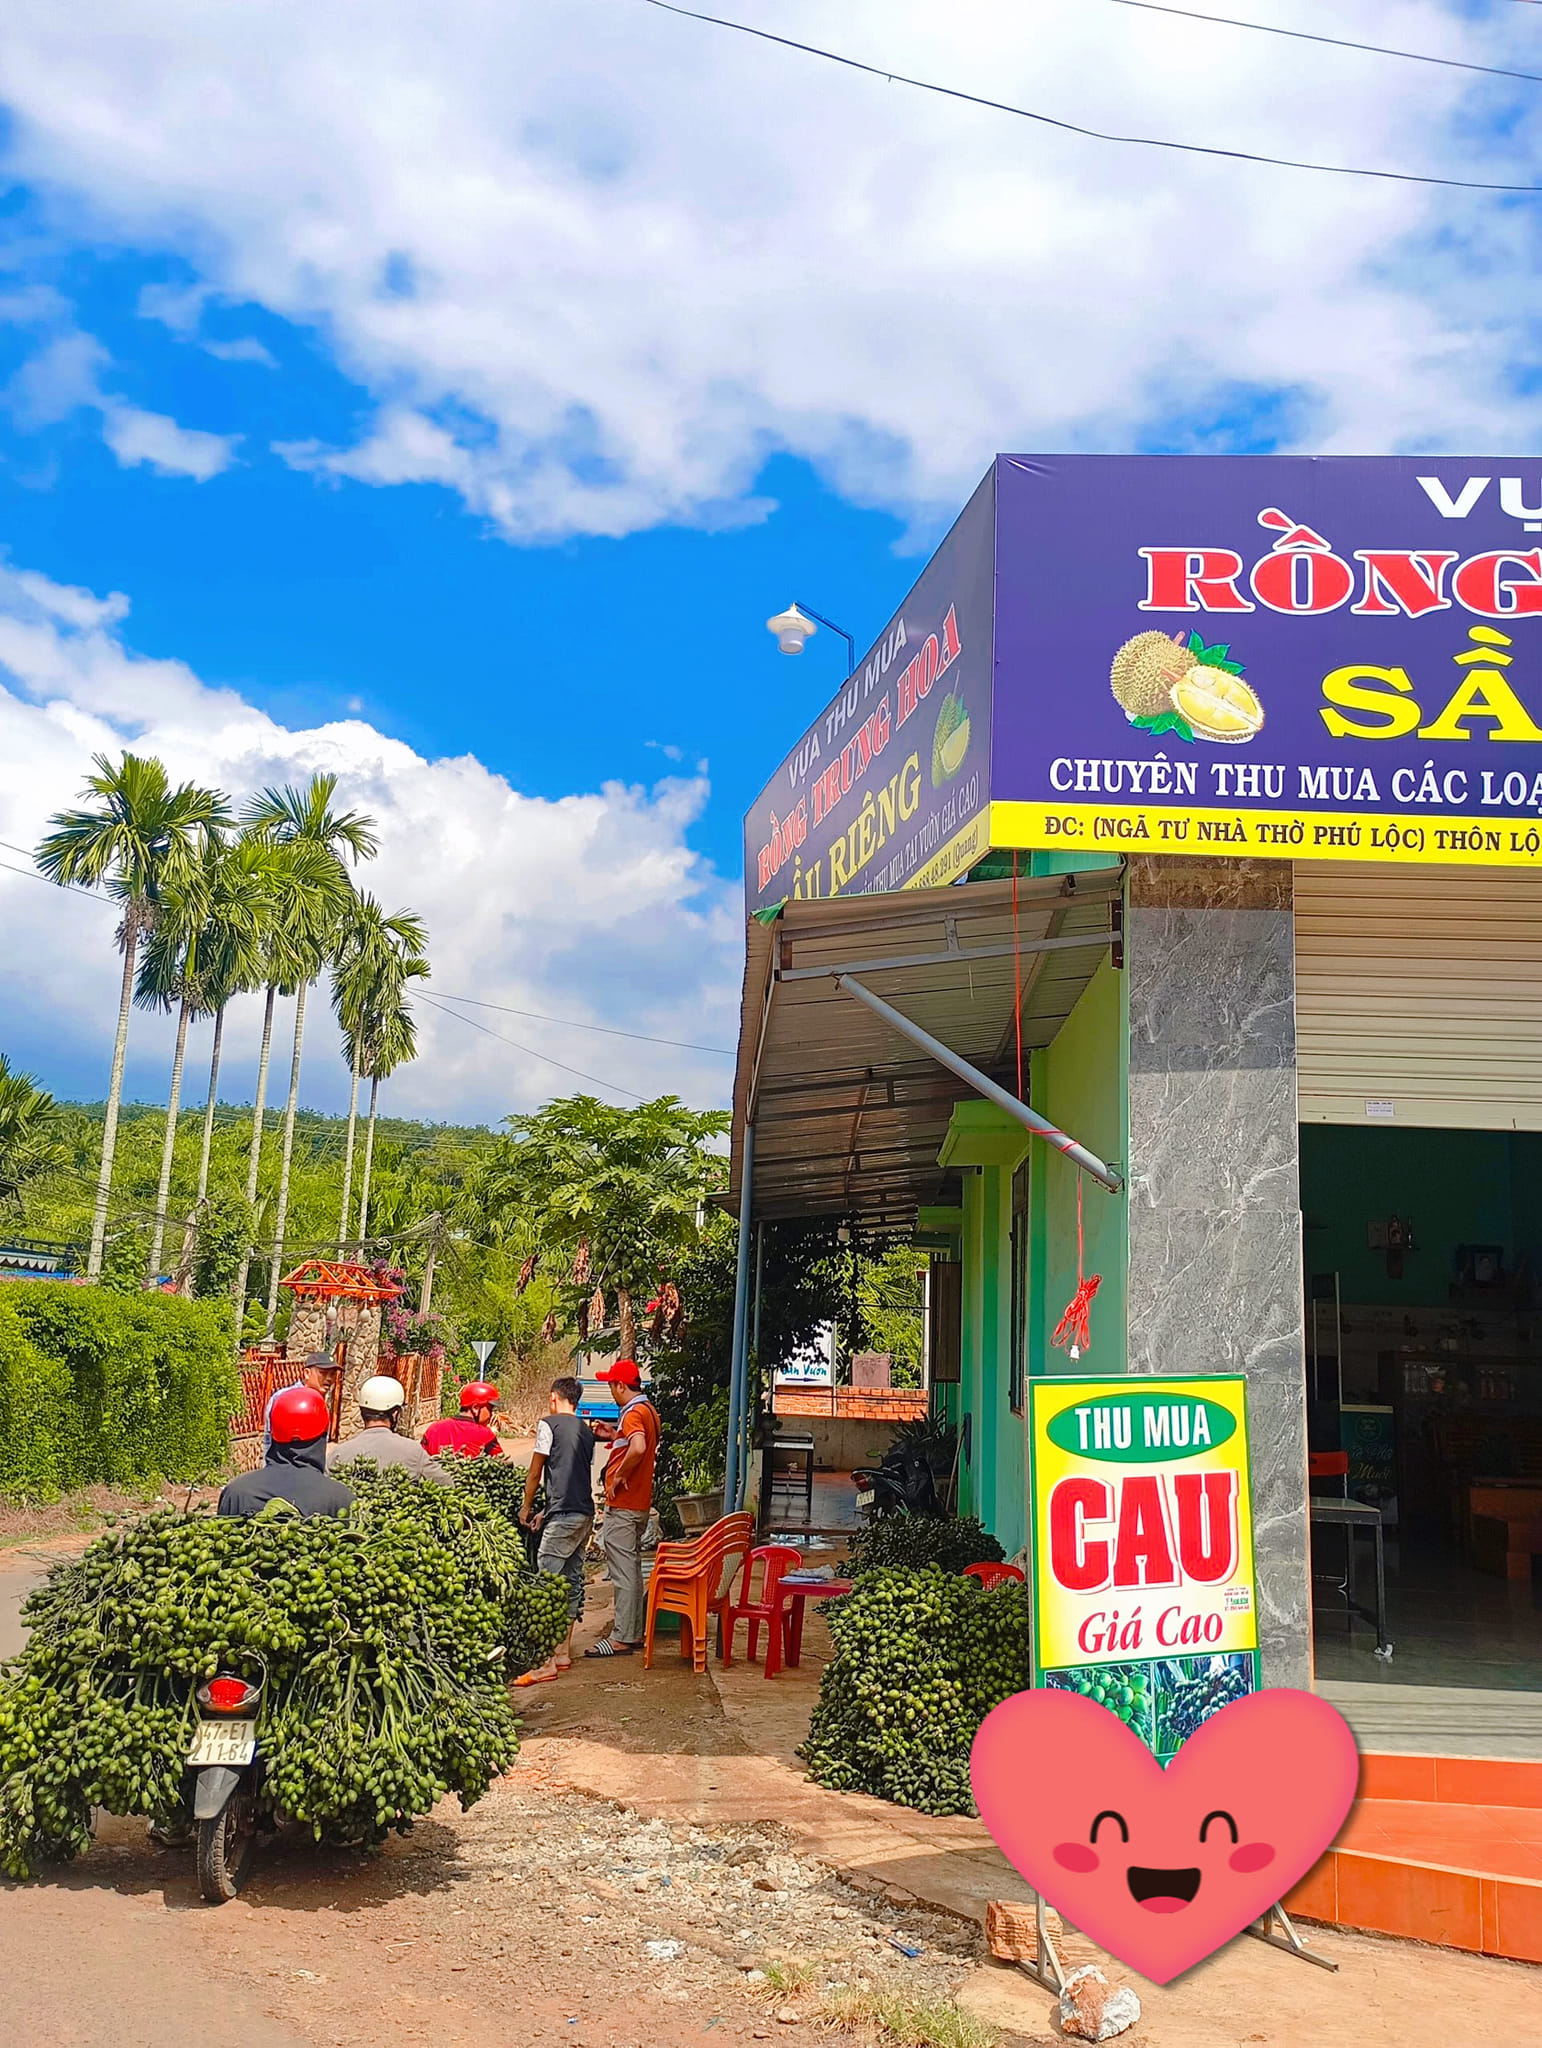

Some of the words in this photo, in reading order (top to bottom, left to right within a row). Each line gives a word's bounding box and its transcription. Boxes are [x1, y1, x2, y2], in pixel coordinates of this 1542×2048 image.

[1137, 508, 1542, 618] RỒNG
[788, 732, 821, 789] VỰA
[826, 680, 859, 745] THU
[864, 618, 908, 699] MUA
[1319, 625, 1542, 742] SẦ
[758, 794, 808, 893] RỒNG
[811, 690, 892, 829] TRUNG
[896, 602, 962, 732] HOA
[1049, 752, 1198, 796] CHUYÊN
[1211, 763, 1285, 798] THU
[1298, 766, 1380, 802] MUA
[1392, 760, 1468, 805] CÁC
[782, 855, 822, 901] ẦU
[828, 752, 923, 897] RIÊNG
[889, 850, 905, 887] MUA
[905, 834, 918, 873] TẠI
[942, 788, 957, 833] GIÁ
[958, 770, 980, 819] CAO)
[1045, 816, 1084, 837] ĐC:
[1093, 815, 1150, 840] (NGÃ
[1159, 816, 1191, 840] TƯ
[1198, 815, 1248, 842] NHÀ
[1256, 819, 1305, 845] THỜ
[1313, 820, 1361, 847] PHÚ
[1371, 823, 1426, 852] LỘC)
[1435, 825, 1501, 851] THÔN
[1074, 1406, 1132, 1451] THU
[1143, 1404, 1212, 1448] MUA
[1049, 1469, 1239, 1596] CAU
[1077, 1606, 1143, 1655] Giá
[1155, 1605, 1224, 1648] Cao
[202, 1722, 248, 1741] 47-E1
